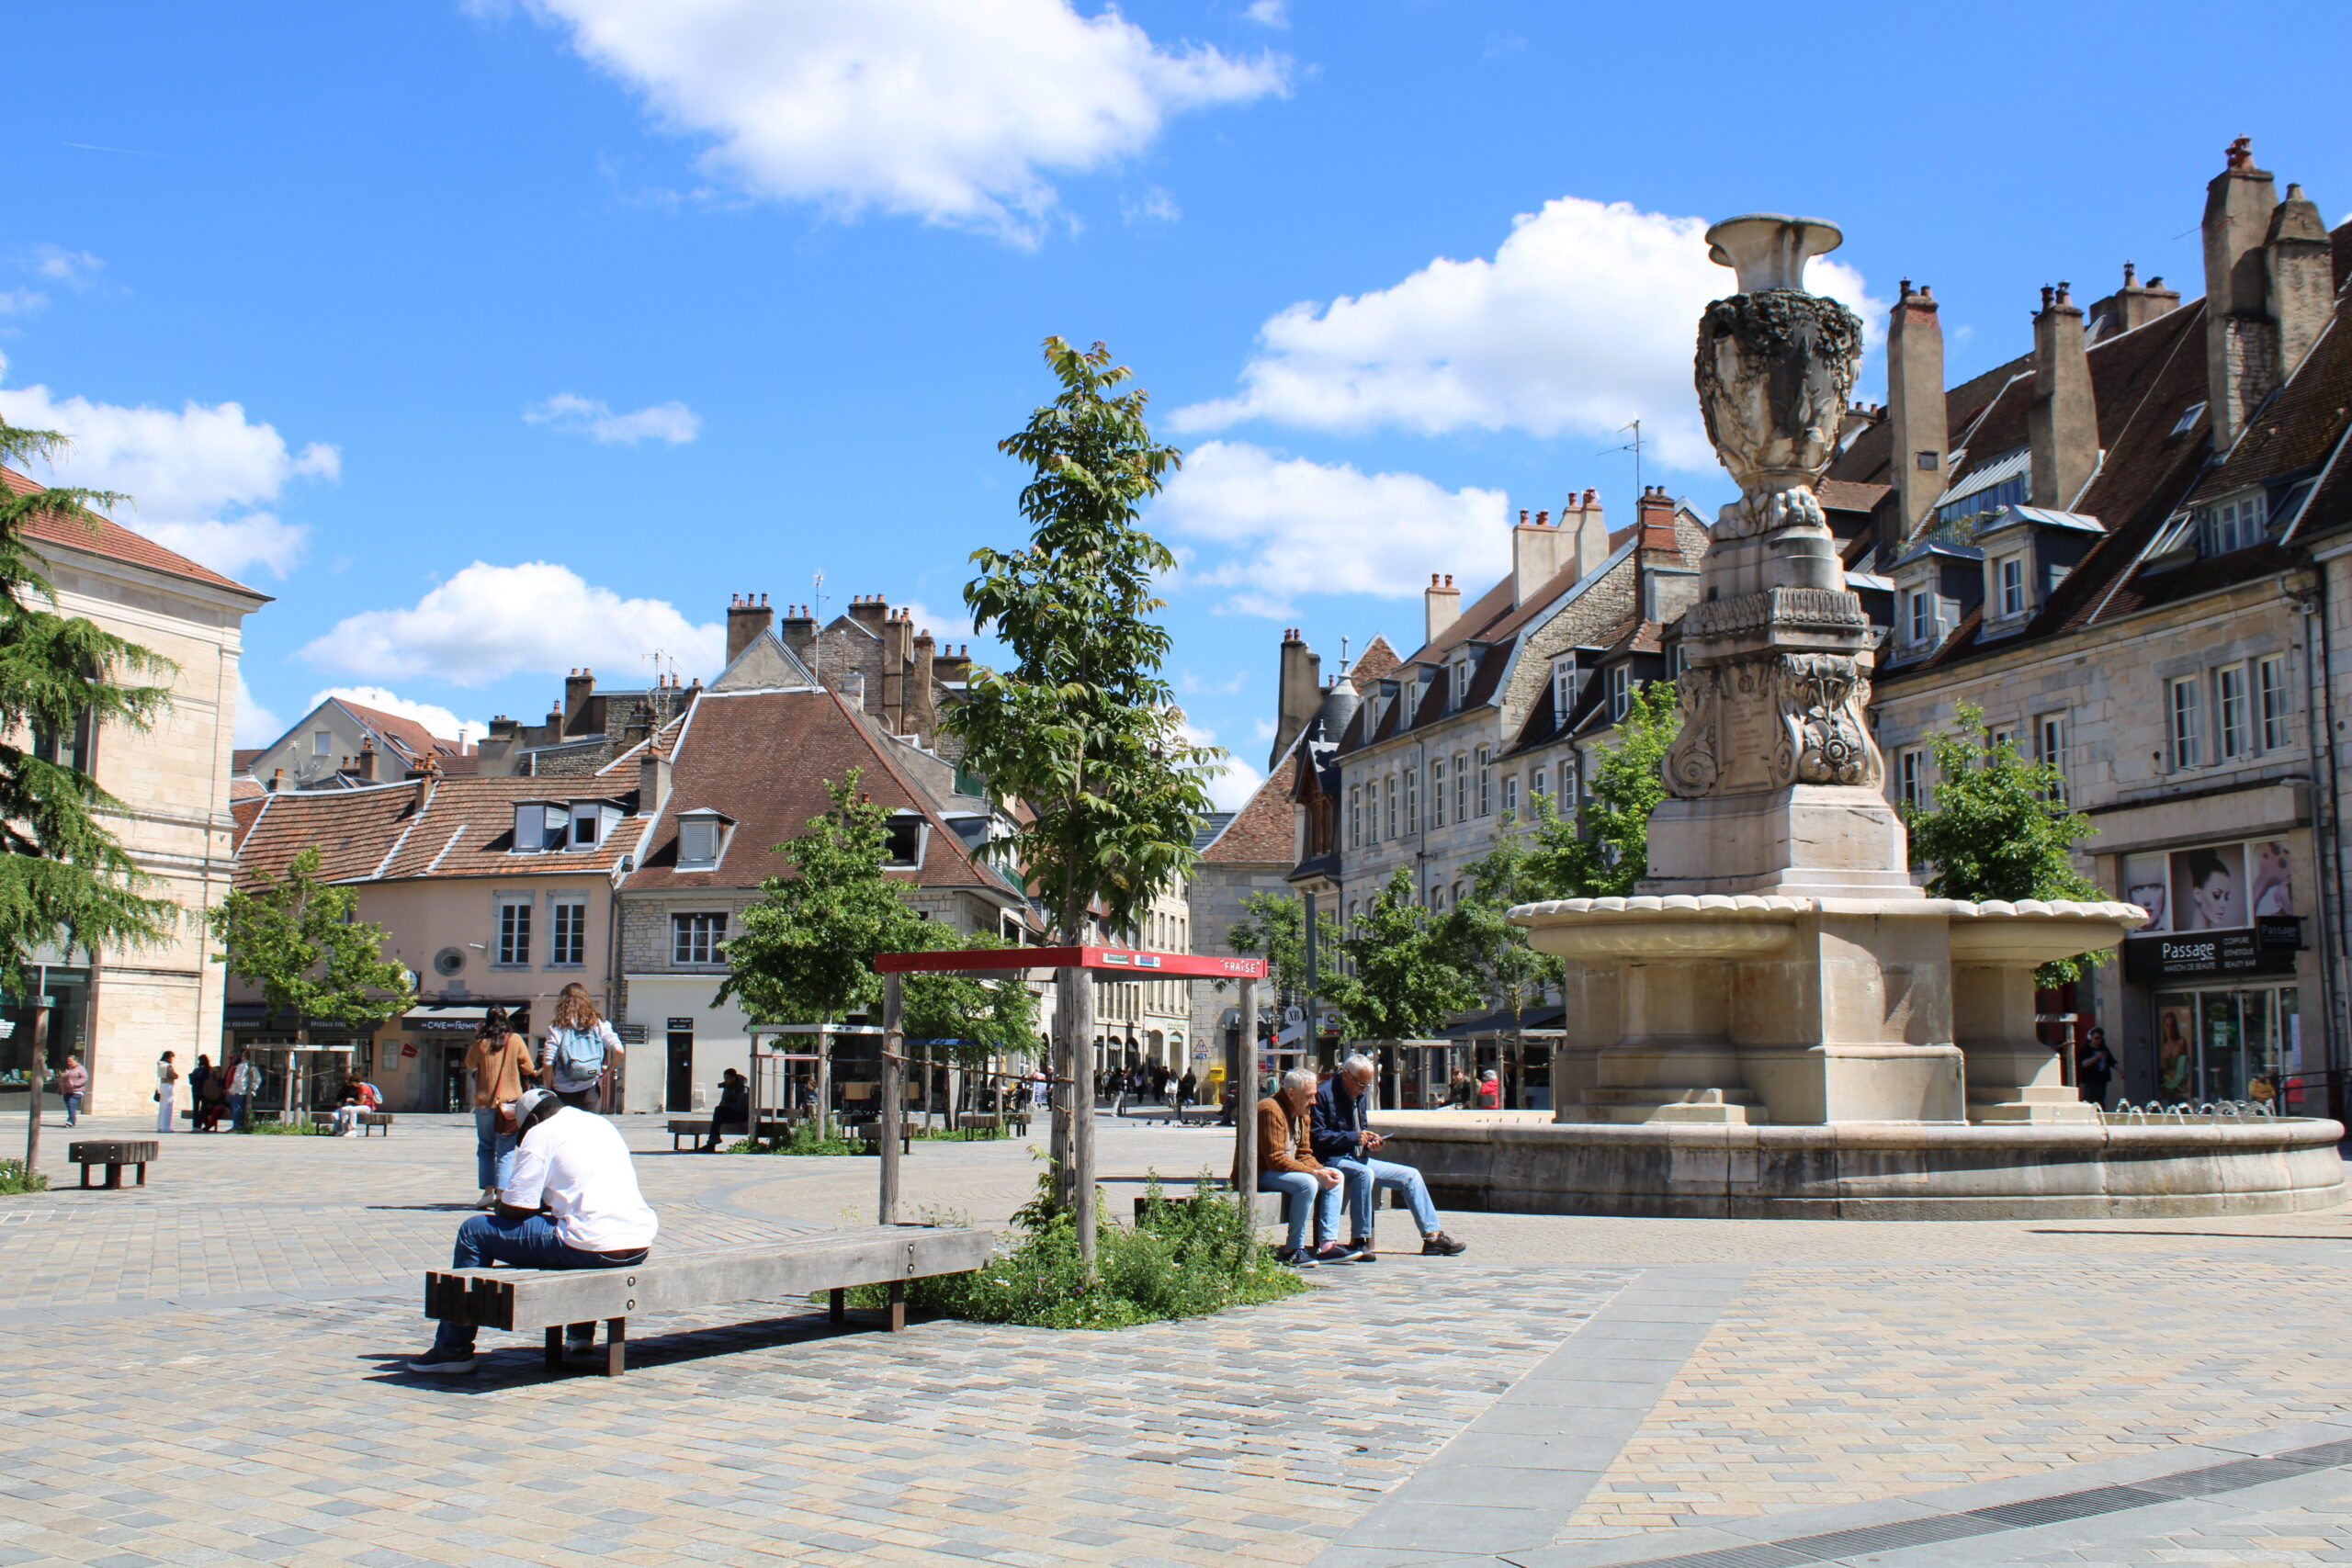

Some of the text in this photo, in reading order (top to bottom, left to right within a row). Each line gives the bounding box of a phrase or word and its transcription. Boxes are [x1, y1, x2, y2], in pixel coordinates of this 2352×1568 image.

[2163, 942, 2215, 961] Passage
[1289, 1010, 1300, 1021] XB
[427, 1021, 447, 1030] CAVE
